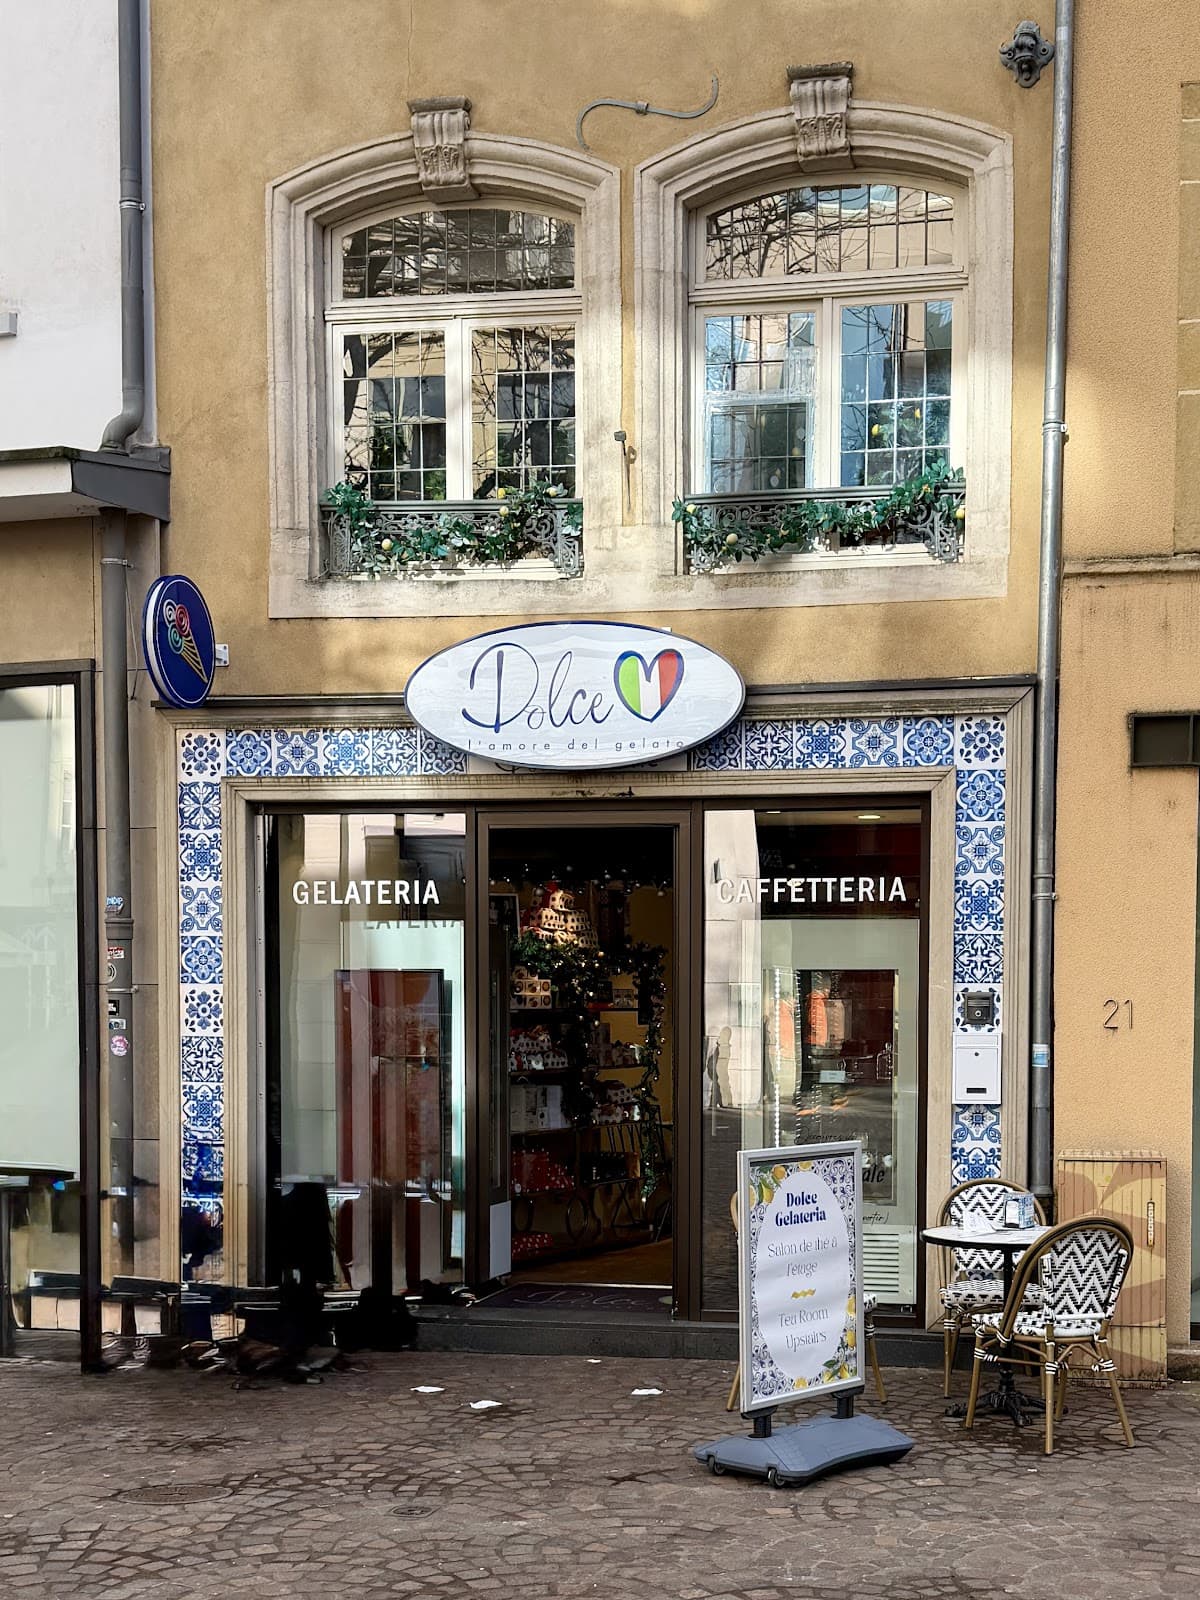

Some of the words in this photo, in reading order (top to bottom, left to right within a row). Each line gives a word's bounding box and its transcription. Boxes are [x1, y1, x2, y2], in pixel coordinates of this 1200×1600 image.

[462, 643, 614, 733] Dolce
[468, 739, 551, 751] l'amore
[567, 738, 598, 751] del
[615, 738, 685, 753] gelato
[292, 879, 440, 905] GELATERIA
[718, 876, 907, 904] CAFFETTERIA
[1103, 999, 1133, 1030] 21
[786, 1191, 818, 1208] Dolce
[775, 1206, 827, 1227] Gelateria
[767, 1241, 797, 1258] Salon
[799, 1239, 812, 1253] de
[814, 1237, 830, 1251] thé
[831, 1235, 838, 1248] à
[778, 1312, 798, 1328] Tea
[799, 1308, 829, 1325] Room
[785, 1330, 828, 1353] Upstairs
